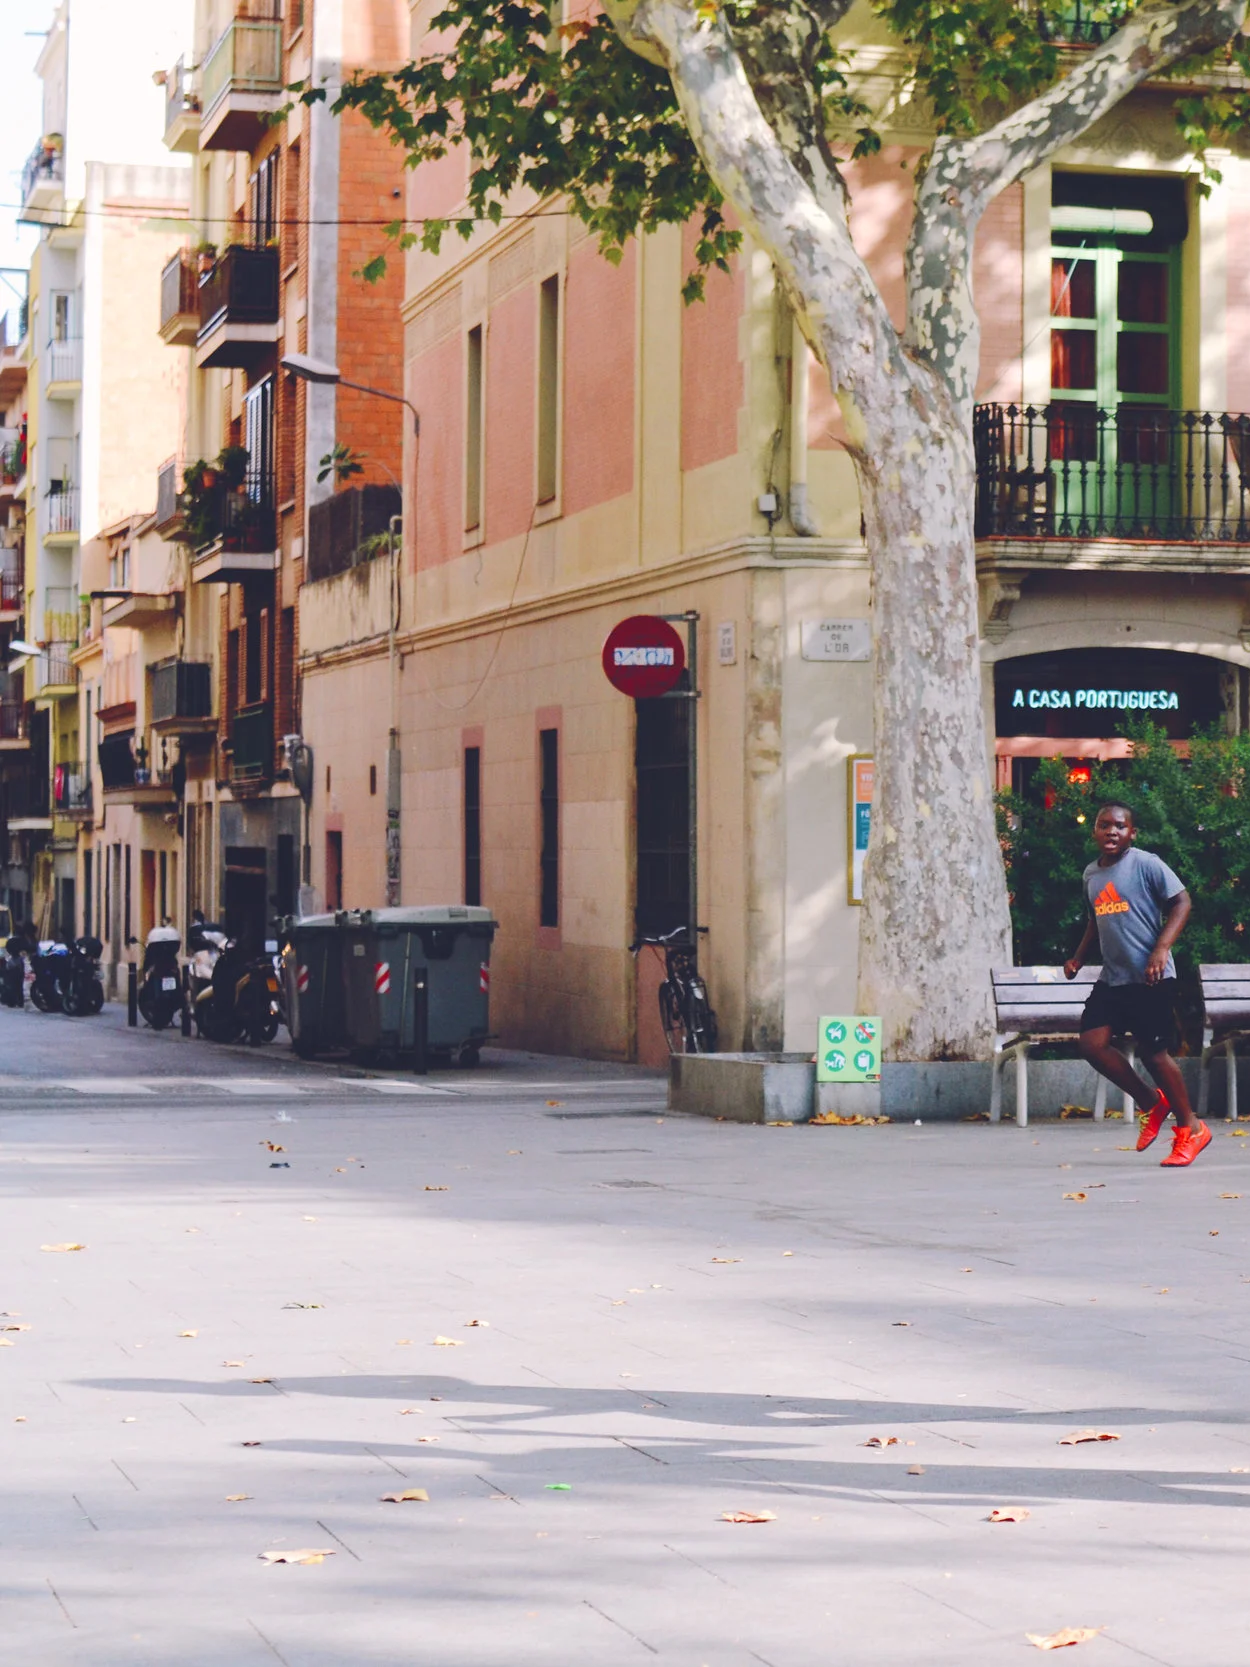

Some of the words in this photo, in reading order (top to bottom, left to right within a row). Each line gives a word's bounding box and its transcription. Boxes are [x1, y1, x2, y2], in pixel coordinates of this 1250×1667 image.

[1012, 689, 1024, 708] A
[1029, 689, 1071, 708] CASA
[1075, 689, 1179, 709] PORTUGUESA
